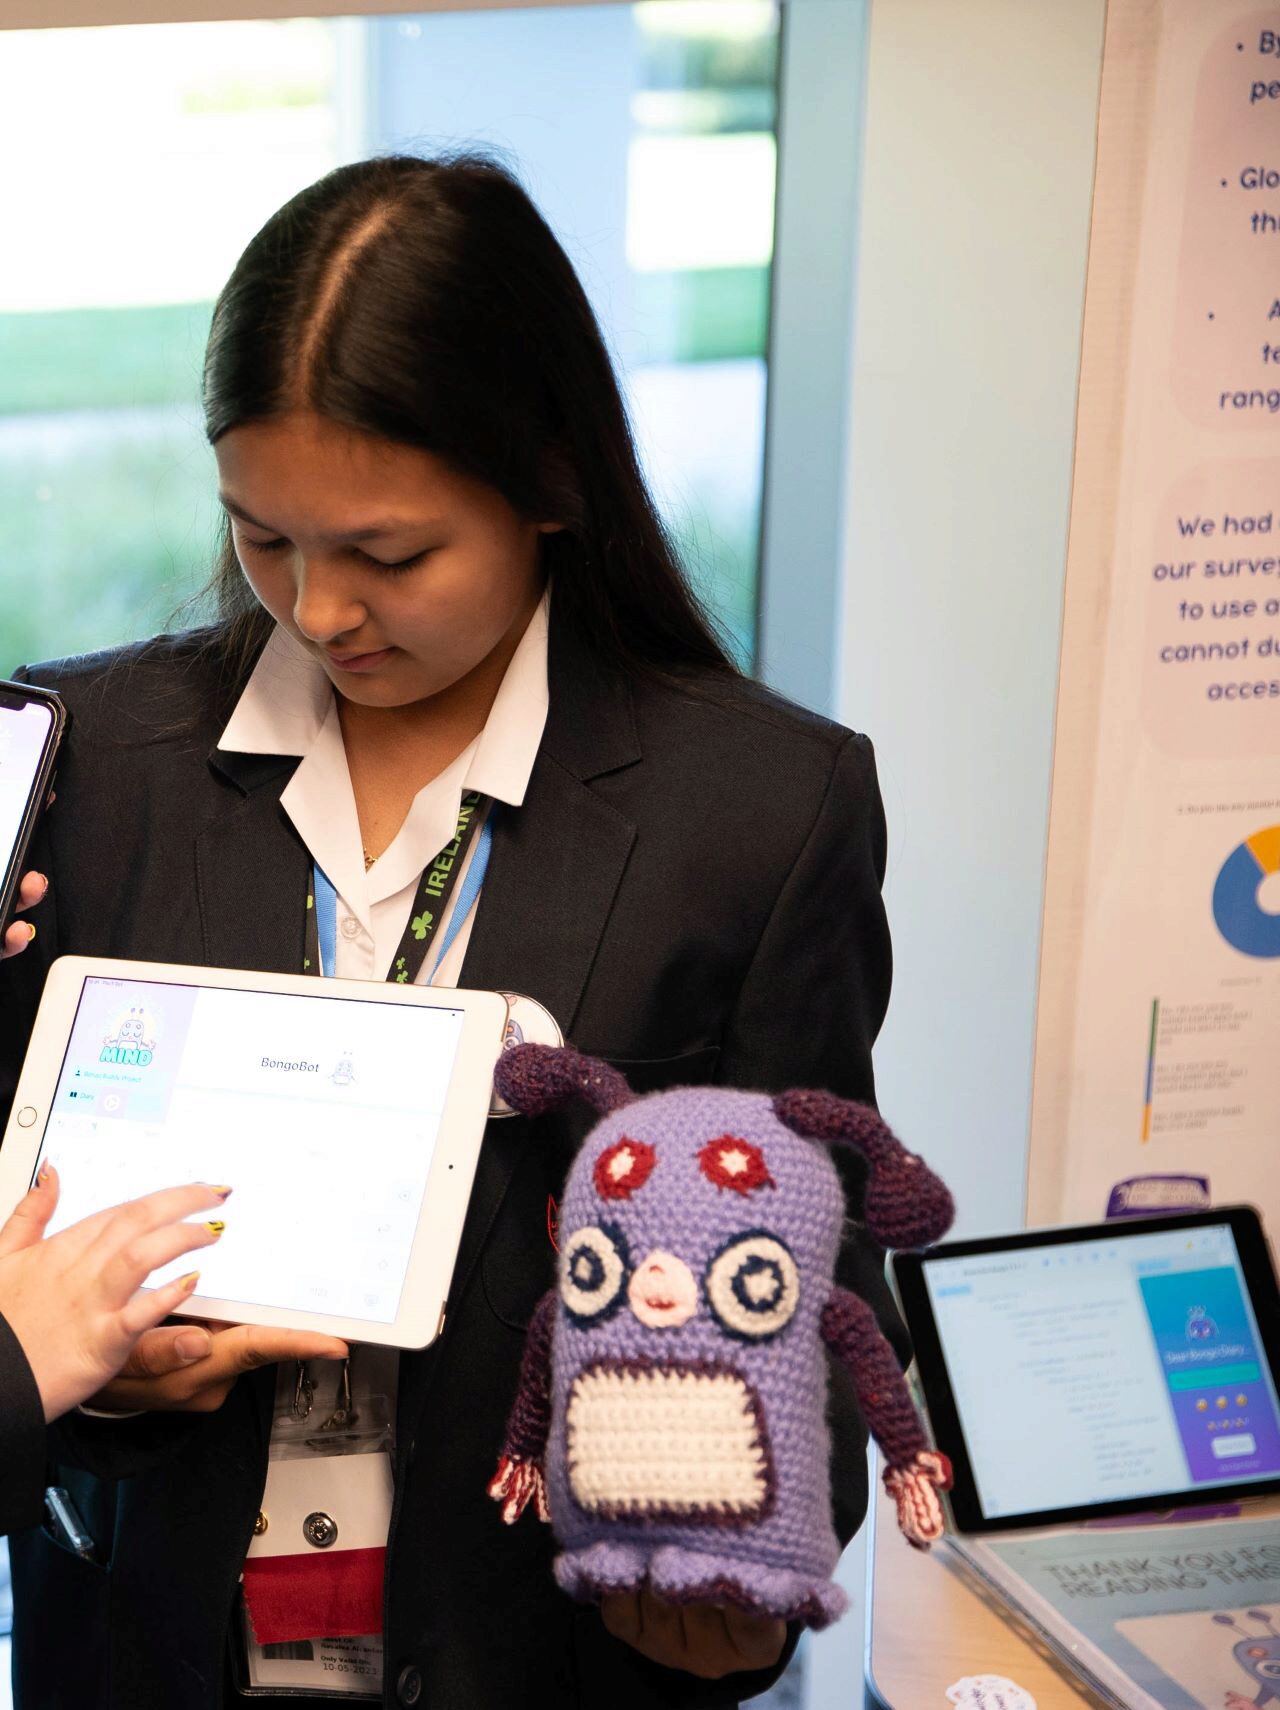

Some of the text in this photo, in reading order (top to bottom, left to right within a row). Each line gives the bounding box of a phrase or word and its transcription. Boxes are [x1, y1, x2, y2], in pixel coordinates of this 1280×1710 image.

[1251, 81, 1280, 105] pe
[1240, 167, 1280, 190] Glo
[1252, 211, 1280, 234] th
[1220, 390, 1280, 414] rang
[1177, 511, 1273, 537] We had
[1153, 556, 1280, 581] our surve
[1179, 600, 1204, 621] to
[1211, 600, 1257, 619] use
[1160, 637, 1250, 663] cannot
[1207, 680, 1280, 701] acces
[99, 1045, 153, 1067] MIND
[260, 1056, 320, 1074] BongoBot
[1043, 1558, 1164, 1583] THANK
[1161, 1549, 1238, 1572] YOU
[1060, 1571, 1208, 1599] READING
[320, 1655, 337, 1664] Only
